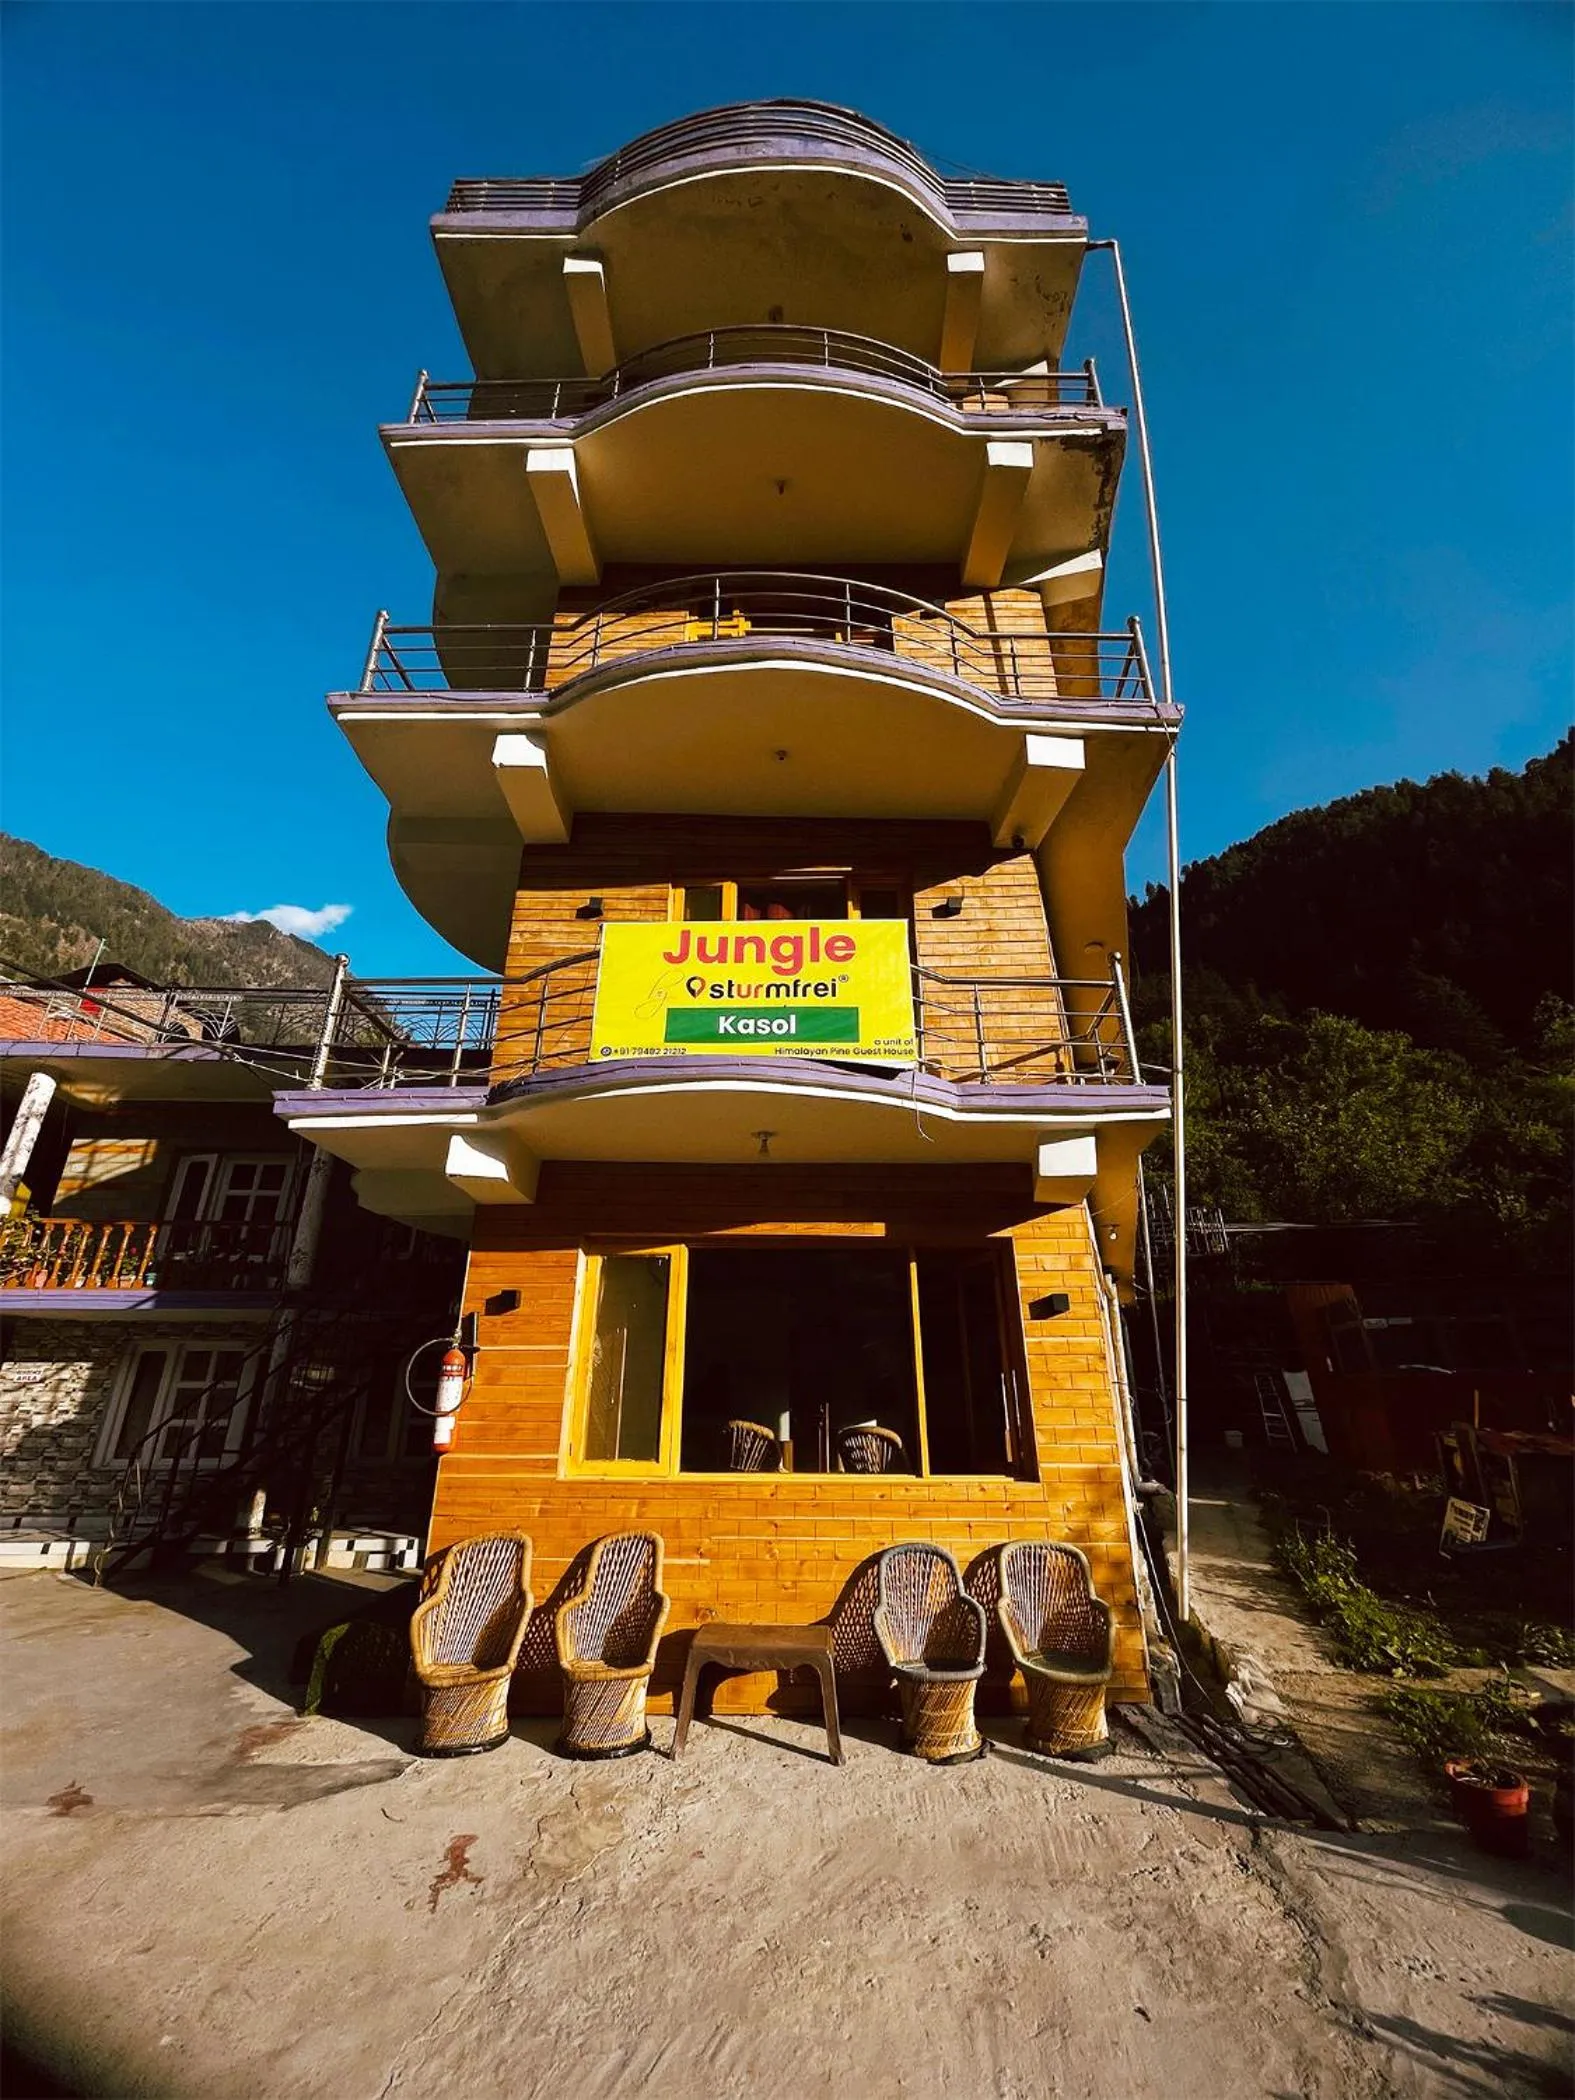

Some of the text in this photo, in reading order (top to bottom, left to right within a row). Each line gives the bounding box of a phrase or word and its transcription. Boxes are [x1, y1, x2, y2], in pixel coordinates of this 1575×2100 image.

[663, 927, 856, 976] Jungle
[718, 1015, 797, 1034] Kasol
[883, 1038, 903, 1046] unit
[904, 1038, 914, 1046] of
[775, 1046, 914, 1057] Himalayan Pine Guest House
